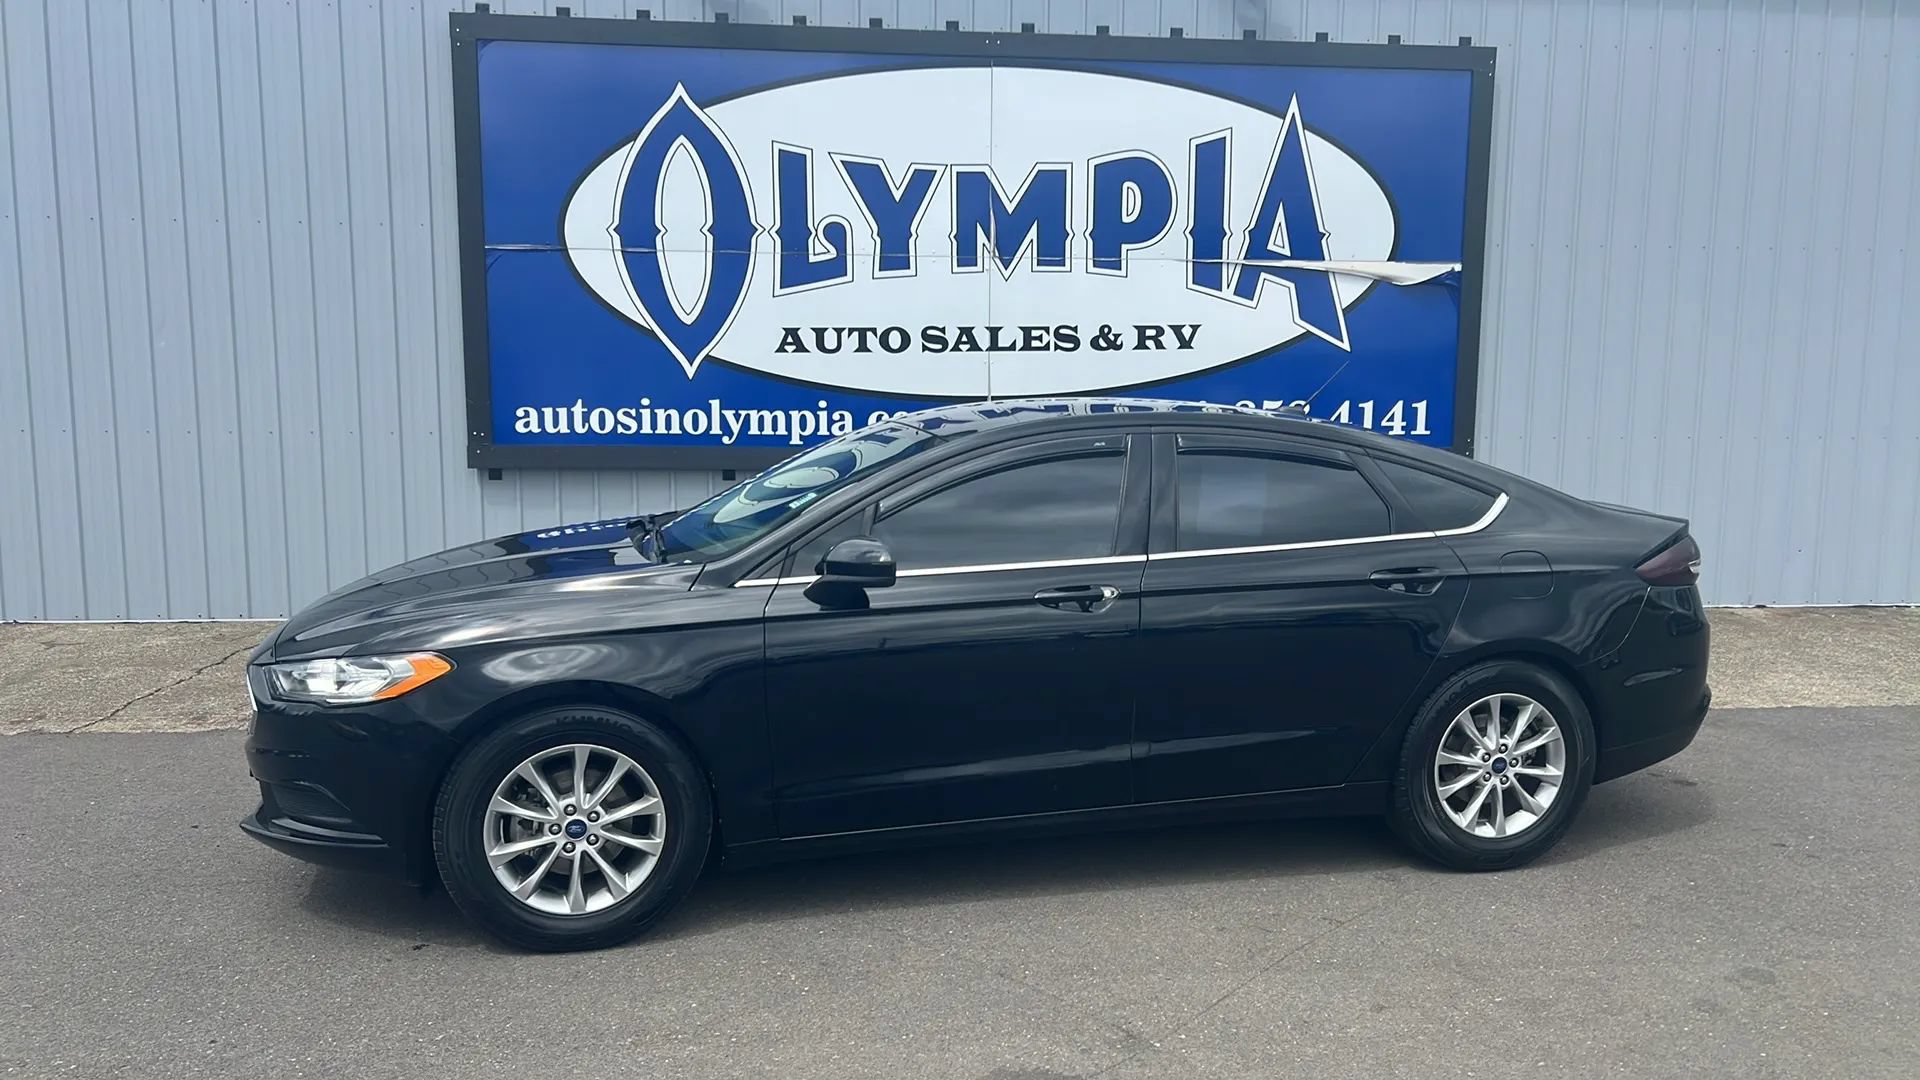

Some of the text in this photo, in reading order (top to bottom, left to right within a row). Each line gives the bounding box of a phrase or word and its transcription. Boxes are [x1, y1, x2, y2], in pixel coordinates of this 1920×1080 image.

[608, 81, 1351, 379] OLYMPIA
[775, 324, 1202, 354] AUTO SALES & RV
